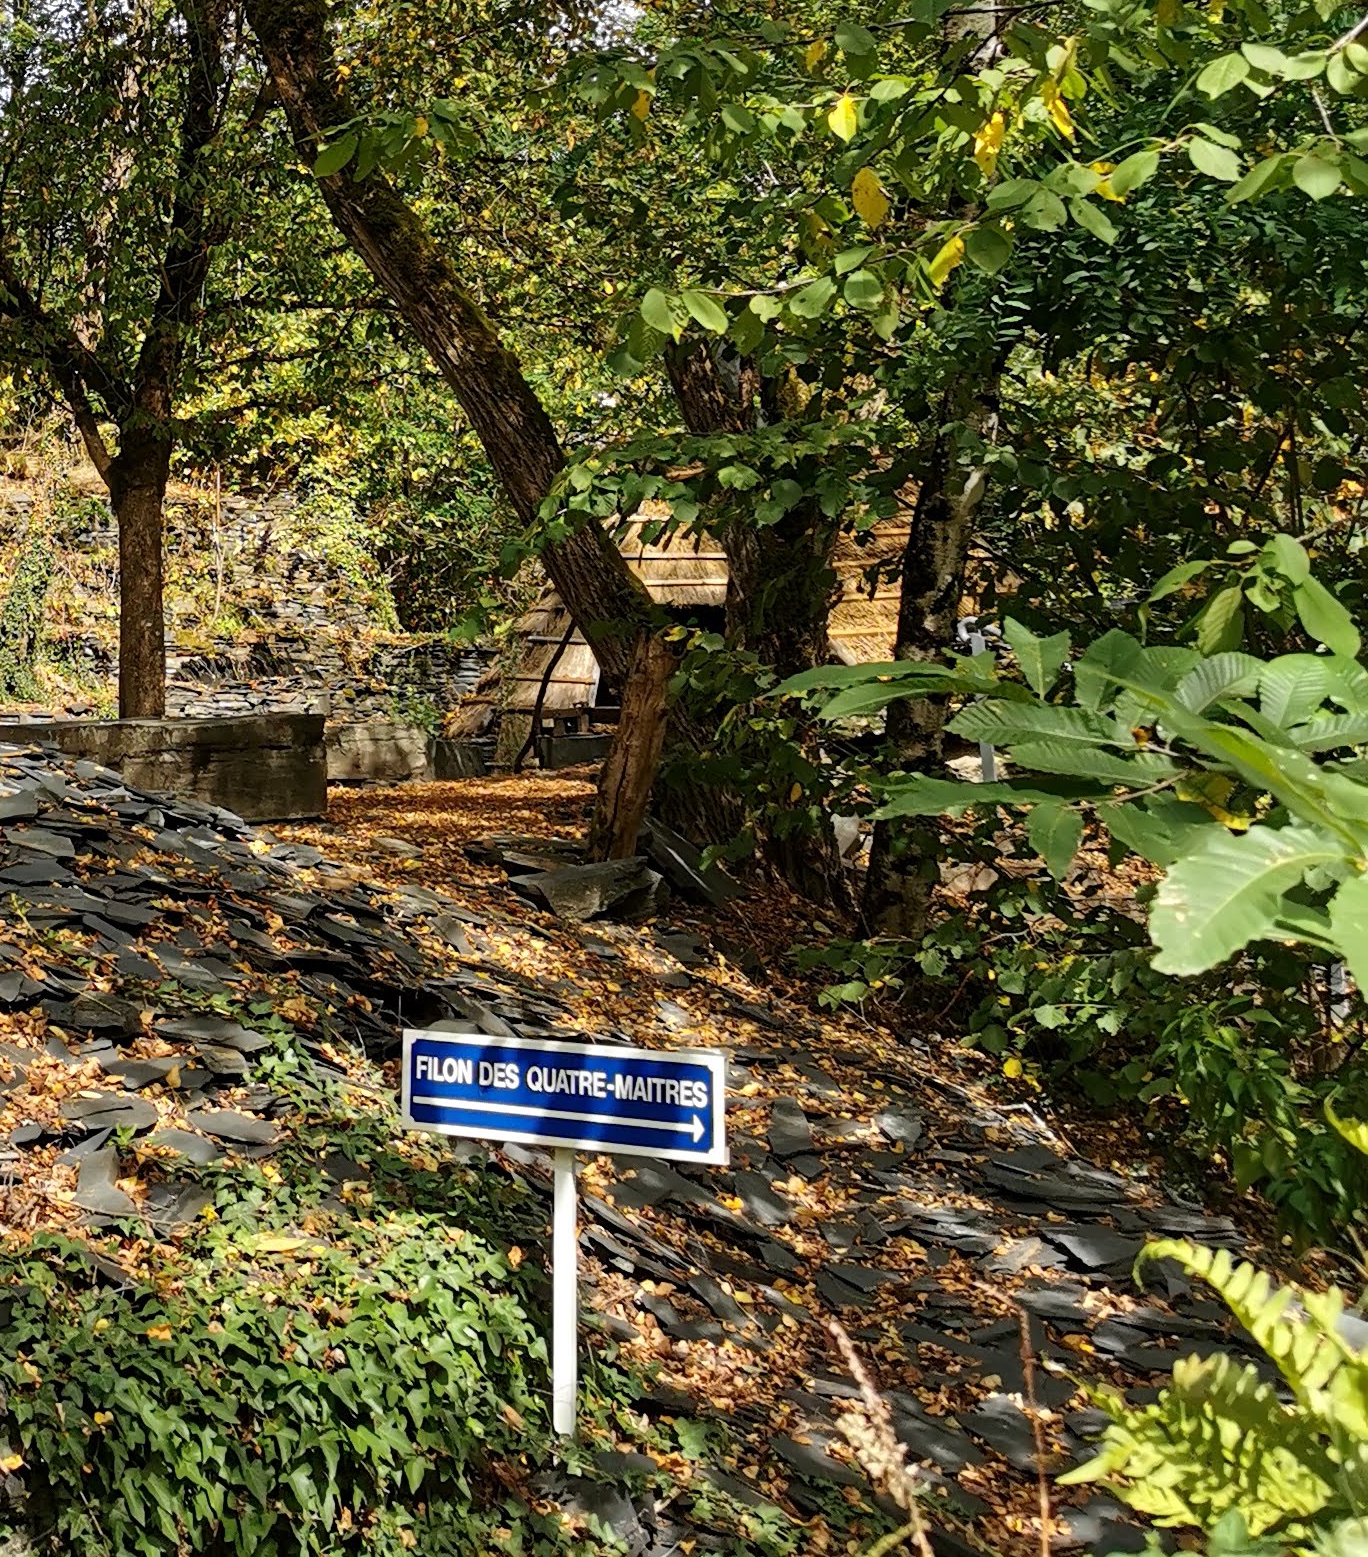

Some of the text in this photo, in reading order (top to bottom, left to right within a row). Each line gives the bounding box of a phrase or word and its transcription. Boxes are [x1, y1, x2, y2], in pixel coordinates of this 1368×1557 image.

[416, 1055, 708, 1109] FILON DES QUATRE-MAITRES
